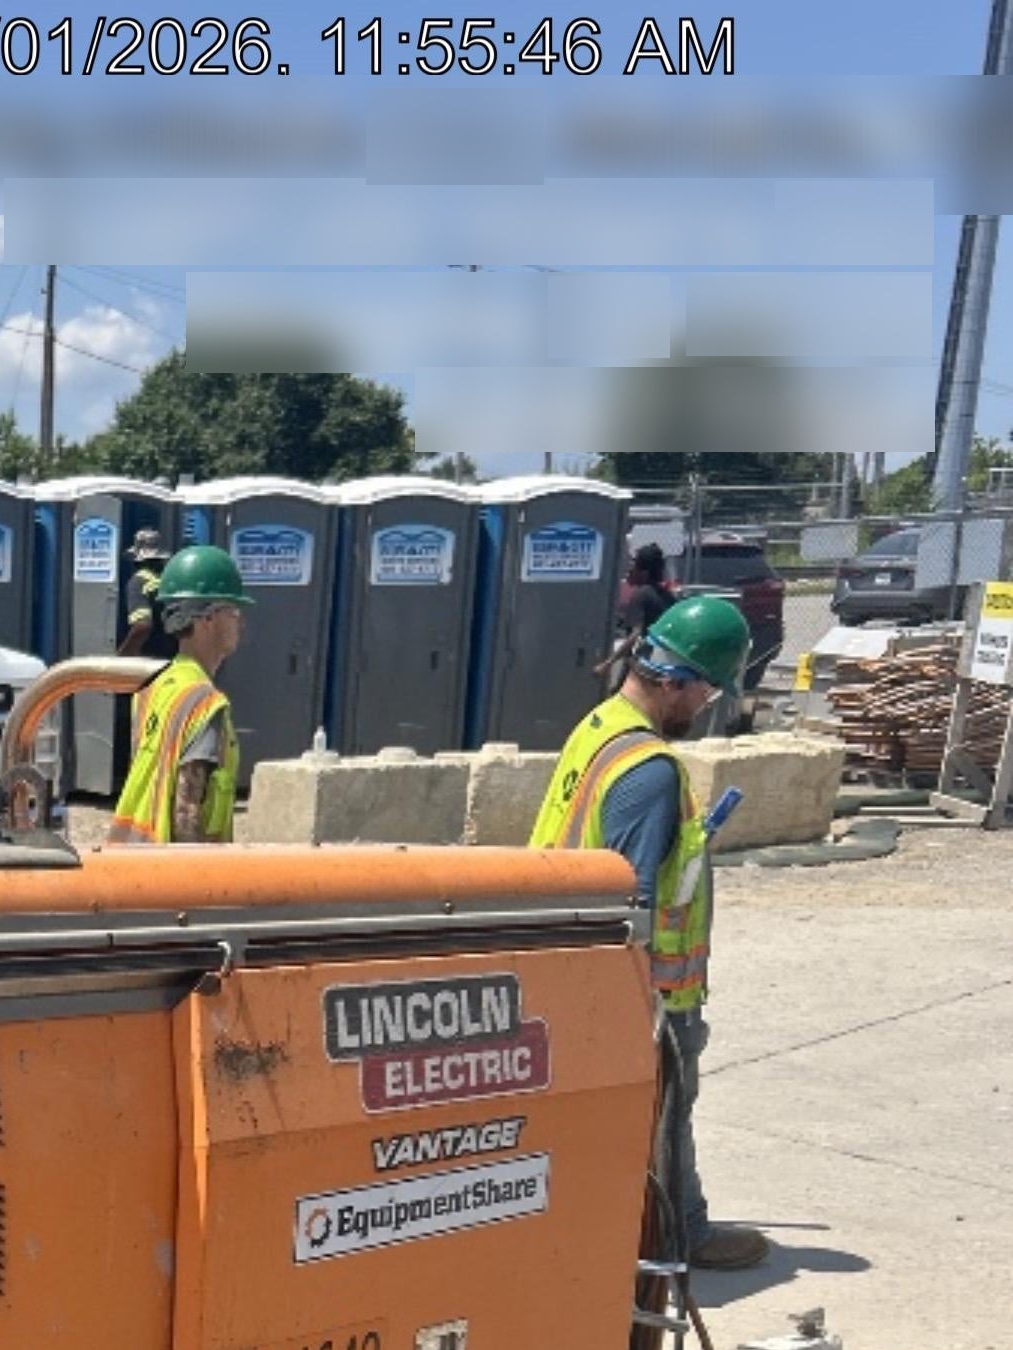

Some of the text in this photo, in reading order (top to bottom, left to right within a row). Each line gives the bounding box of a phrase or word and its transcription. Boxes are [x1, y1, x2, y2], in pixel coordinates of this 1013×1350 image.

[334, 985, 511, 1049] LINCOLN
[385, 1046, 531, 1099] ELECTRIC
[372, 1118, 525, 1172] VANTAGE
[338, 1174, 539, 1240] EquipmentShare
